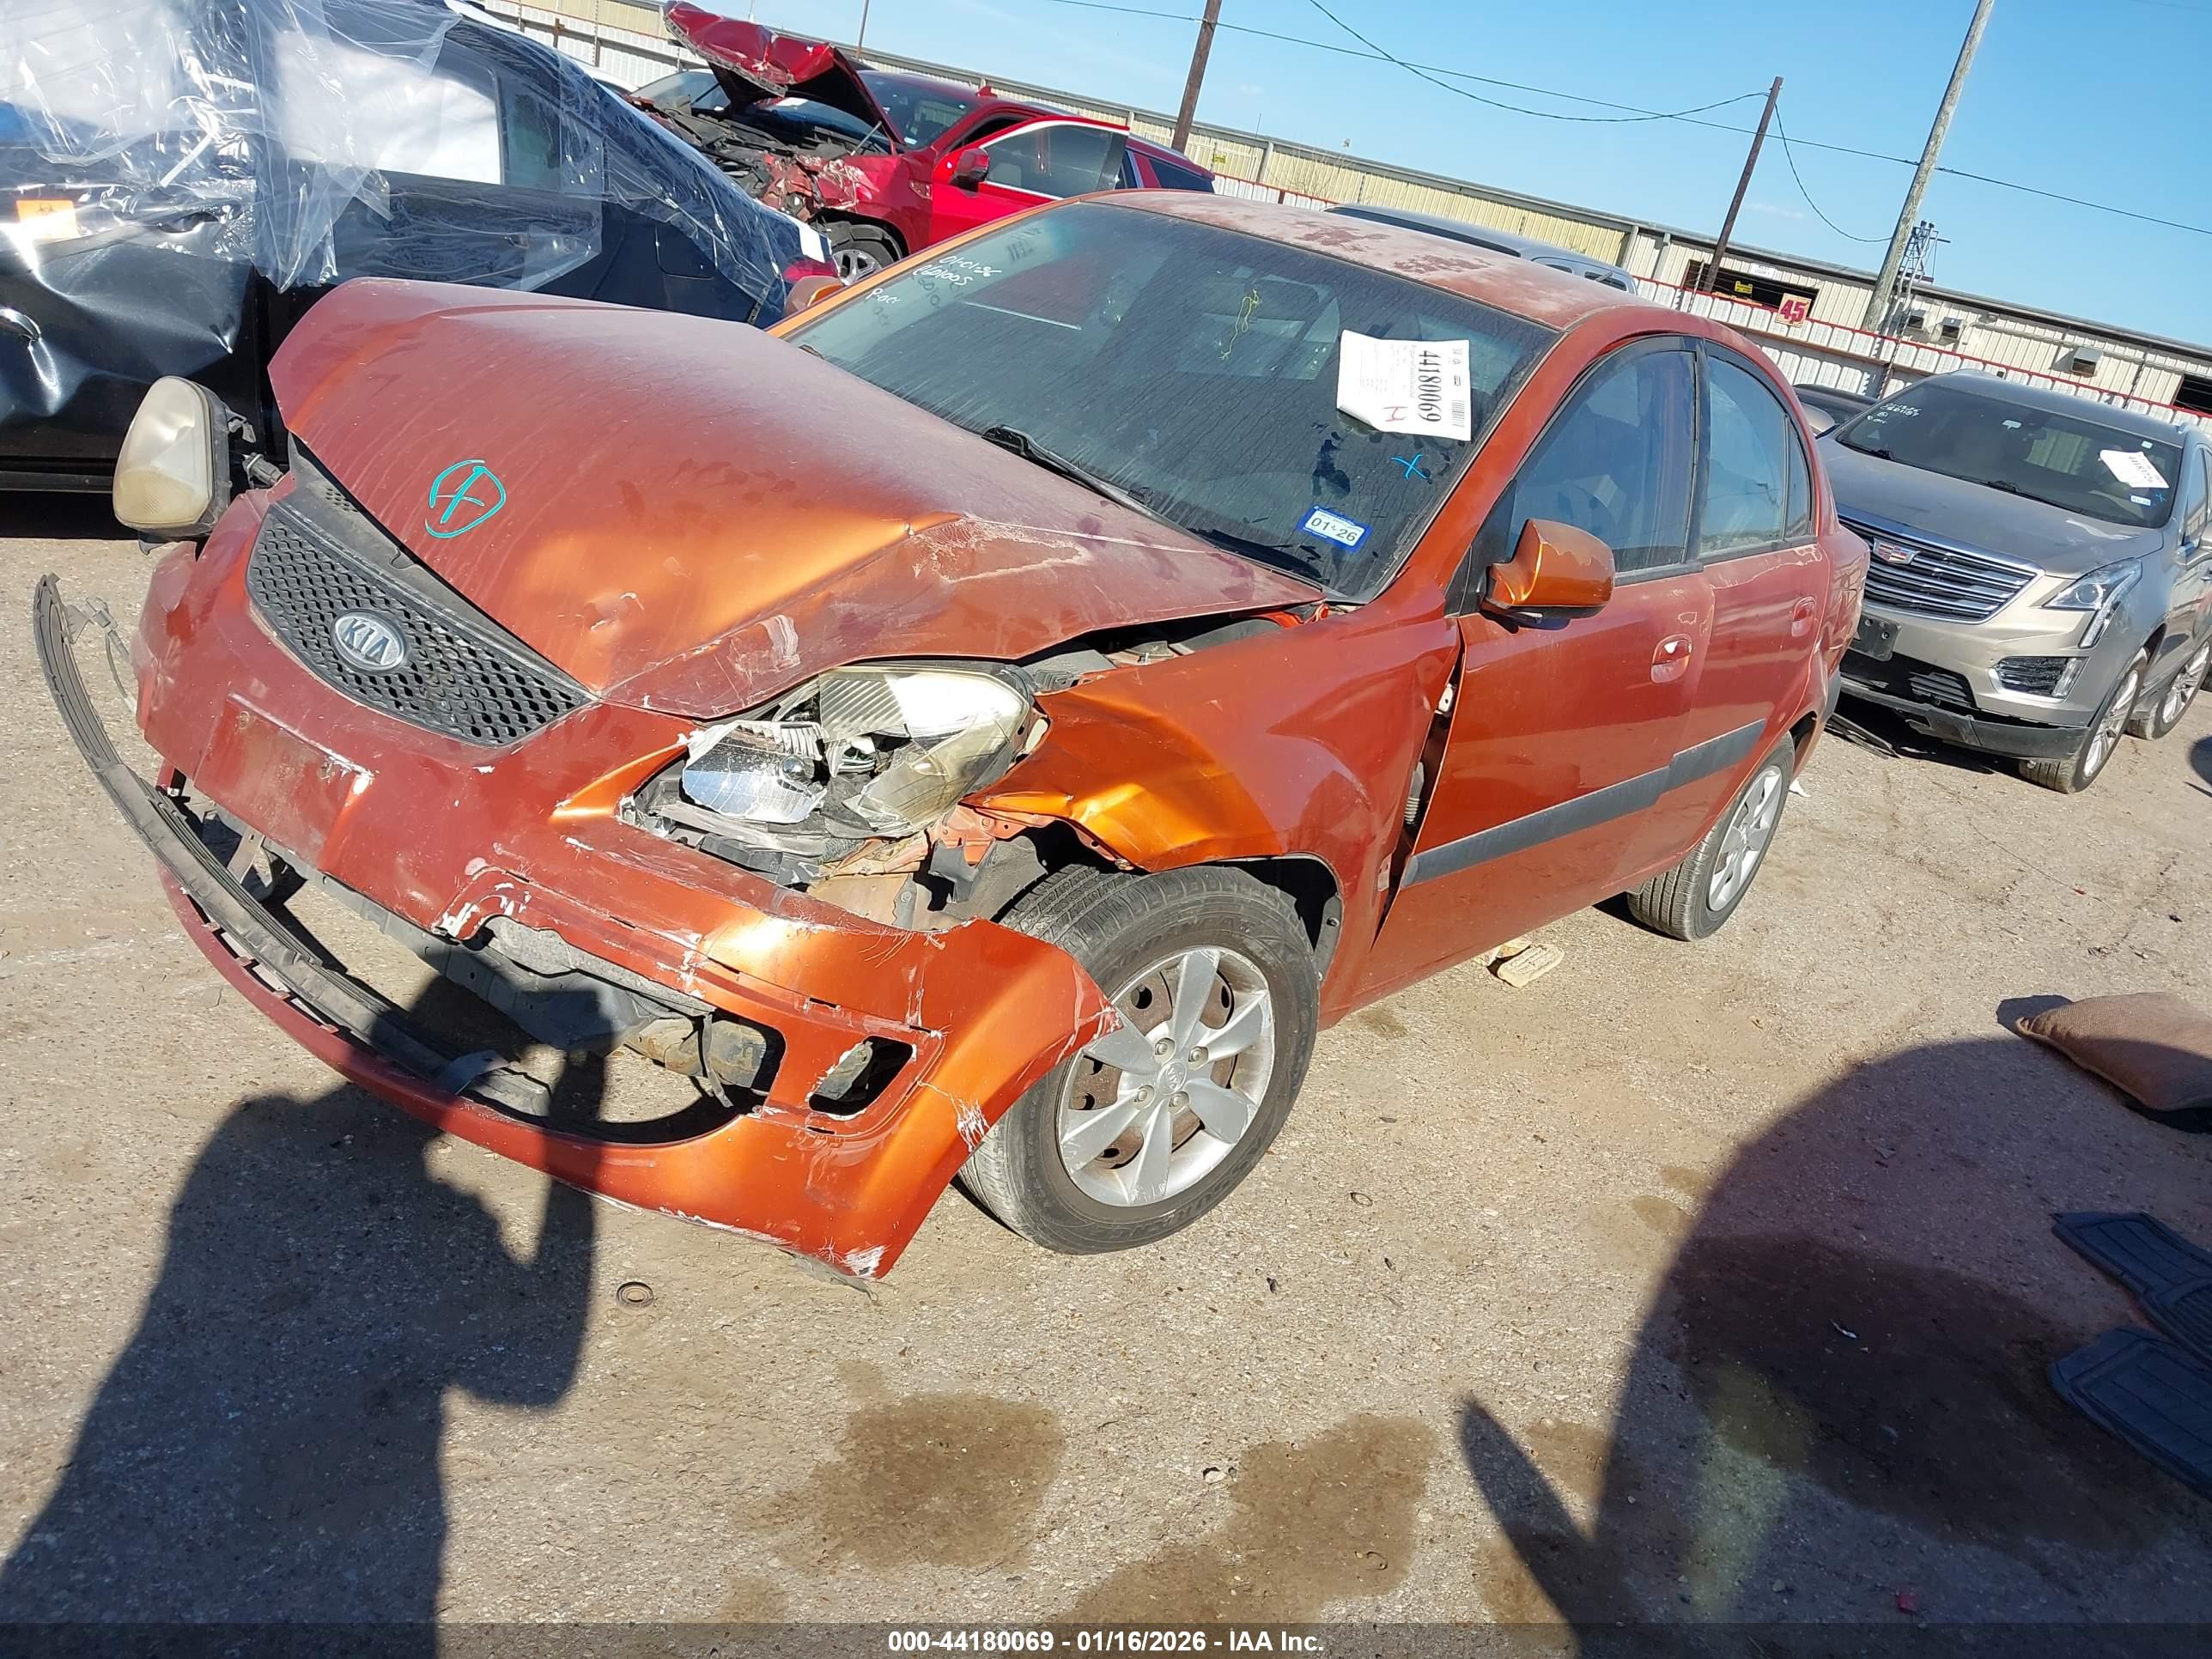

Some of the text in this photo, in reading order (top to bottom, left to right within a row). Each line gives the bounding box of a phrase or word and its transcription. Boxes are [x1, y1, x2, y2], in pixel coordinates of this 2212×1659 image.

[1780, 299, 1806, 324] 45
[1418, 350, 1442, 422] 44180069
[1311, 517, 1331, 531] 01
[1336, 528, 1358, 542] 26
[343, 618, 390, 665] KIA
